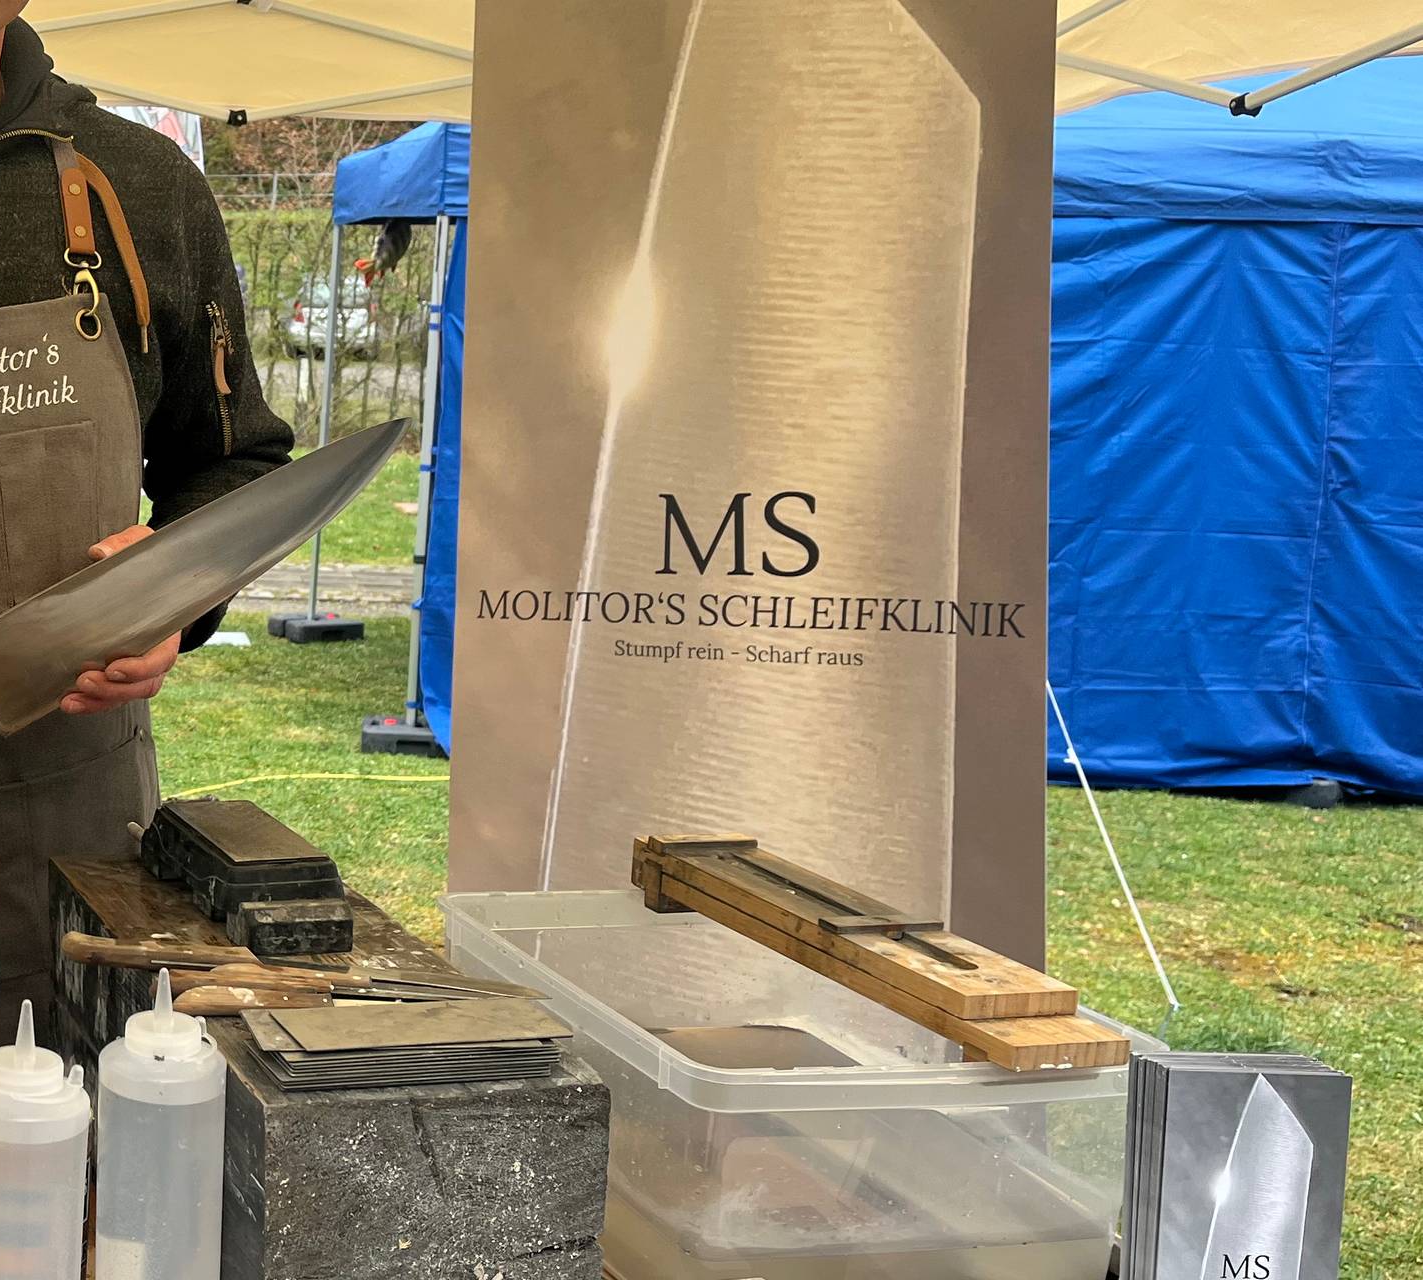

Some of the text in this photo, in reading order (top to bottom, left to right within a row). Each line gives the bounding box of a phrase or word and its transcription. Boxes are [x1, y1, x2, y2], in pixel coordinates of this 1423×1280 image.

[654, 491, 820, 578] MS
[698, 593, 1026, 639] SCHLEIFKLINIK
[614, 639, 684, 663] Stumpf
[687, 643, 724, 661] rein
[746, 645, 813, 665] Scharf
[817, 651, 864, 666] raus
[1220, 1254, 1270, 1280] MS
